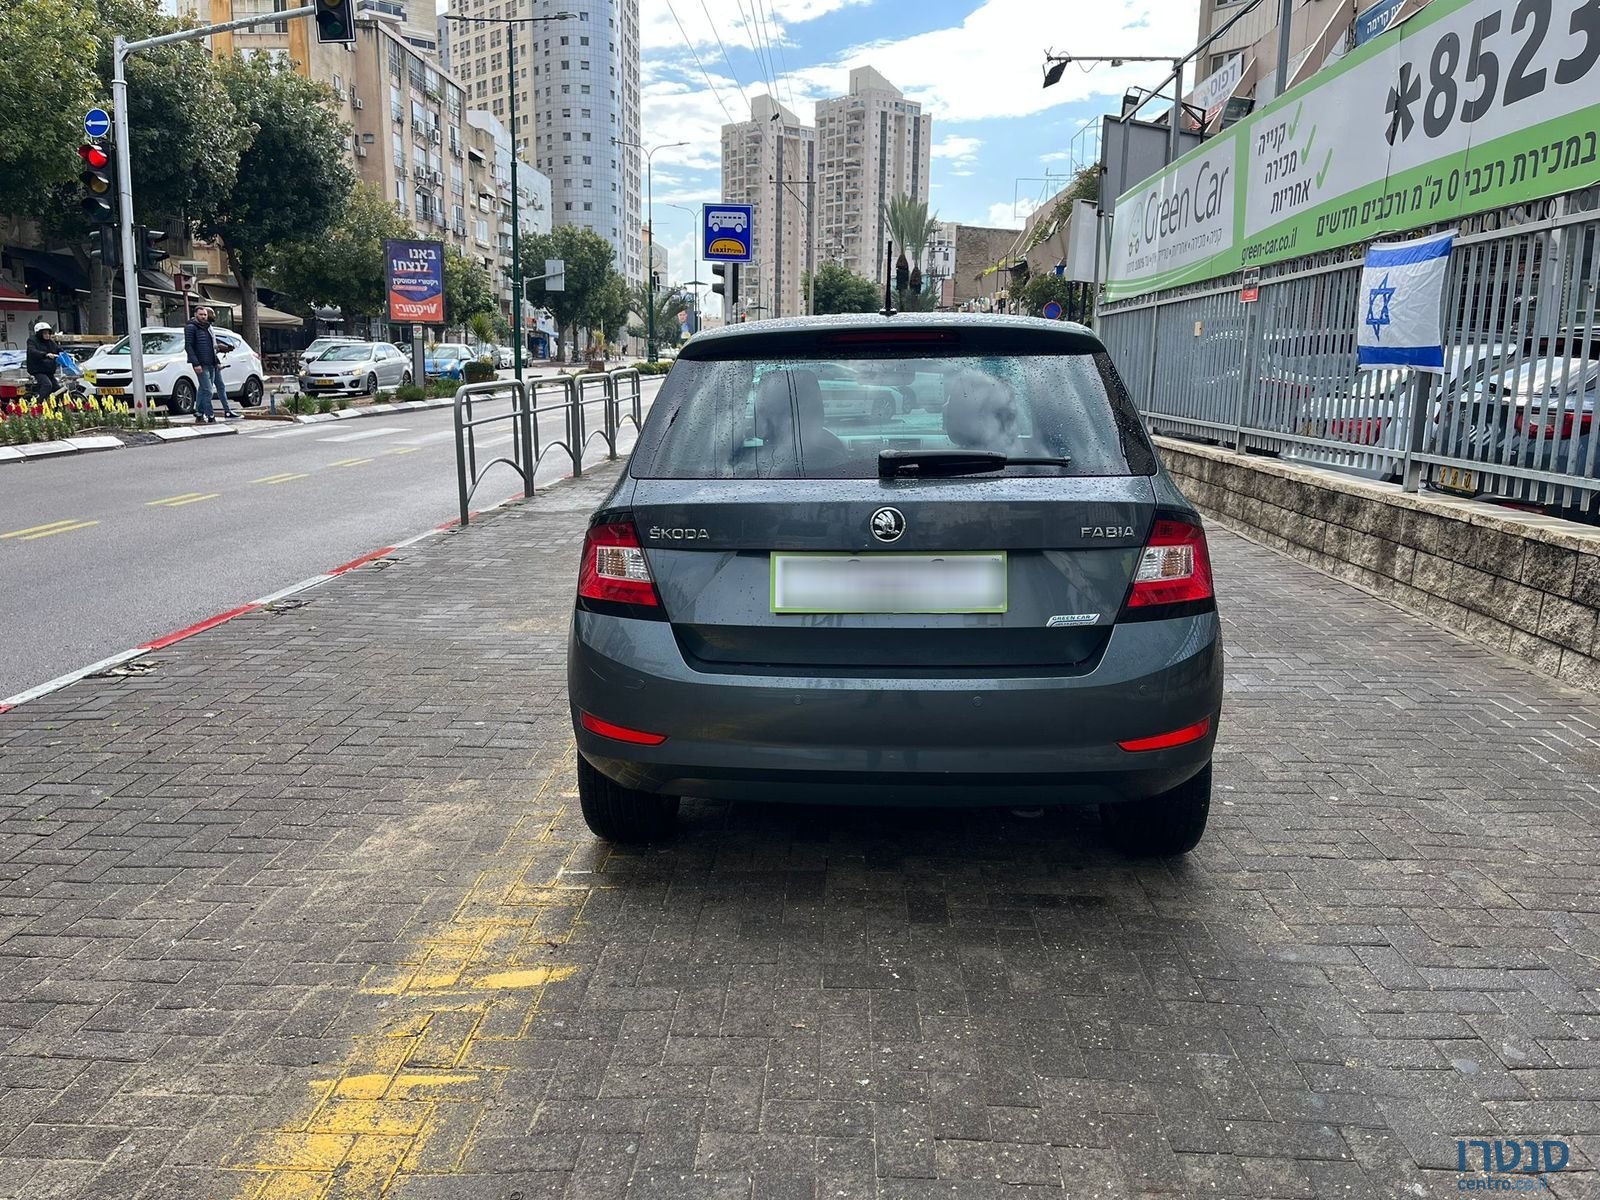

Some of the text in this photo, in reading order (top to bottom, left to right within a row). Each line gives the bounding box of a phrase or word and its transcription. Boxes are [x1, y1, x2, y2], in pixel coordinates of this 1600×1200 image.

[1210, 63, 1237, 97] דפוס
[1258, 122, 1287, 156] קנייה
[1264, 150, 1298, 185] מכירה
[1316, 131, 1597, 237] במכירת רכבי 0 ק"מ ורכבים חדשים
[1144, 160, 1230, 245] Green Car
[1270, 178, 1312, 214] אחריות
[408, 248, 436, 260] באנו
[1241, 227, 1298, 265] green-car.co.il
[393, 259, 429, 272] לנצח!
[649, 525, 710, 539] ŠKODA
[1080, 526, 1136, 538] FABIA
